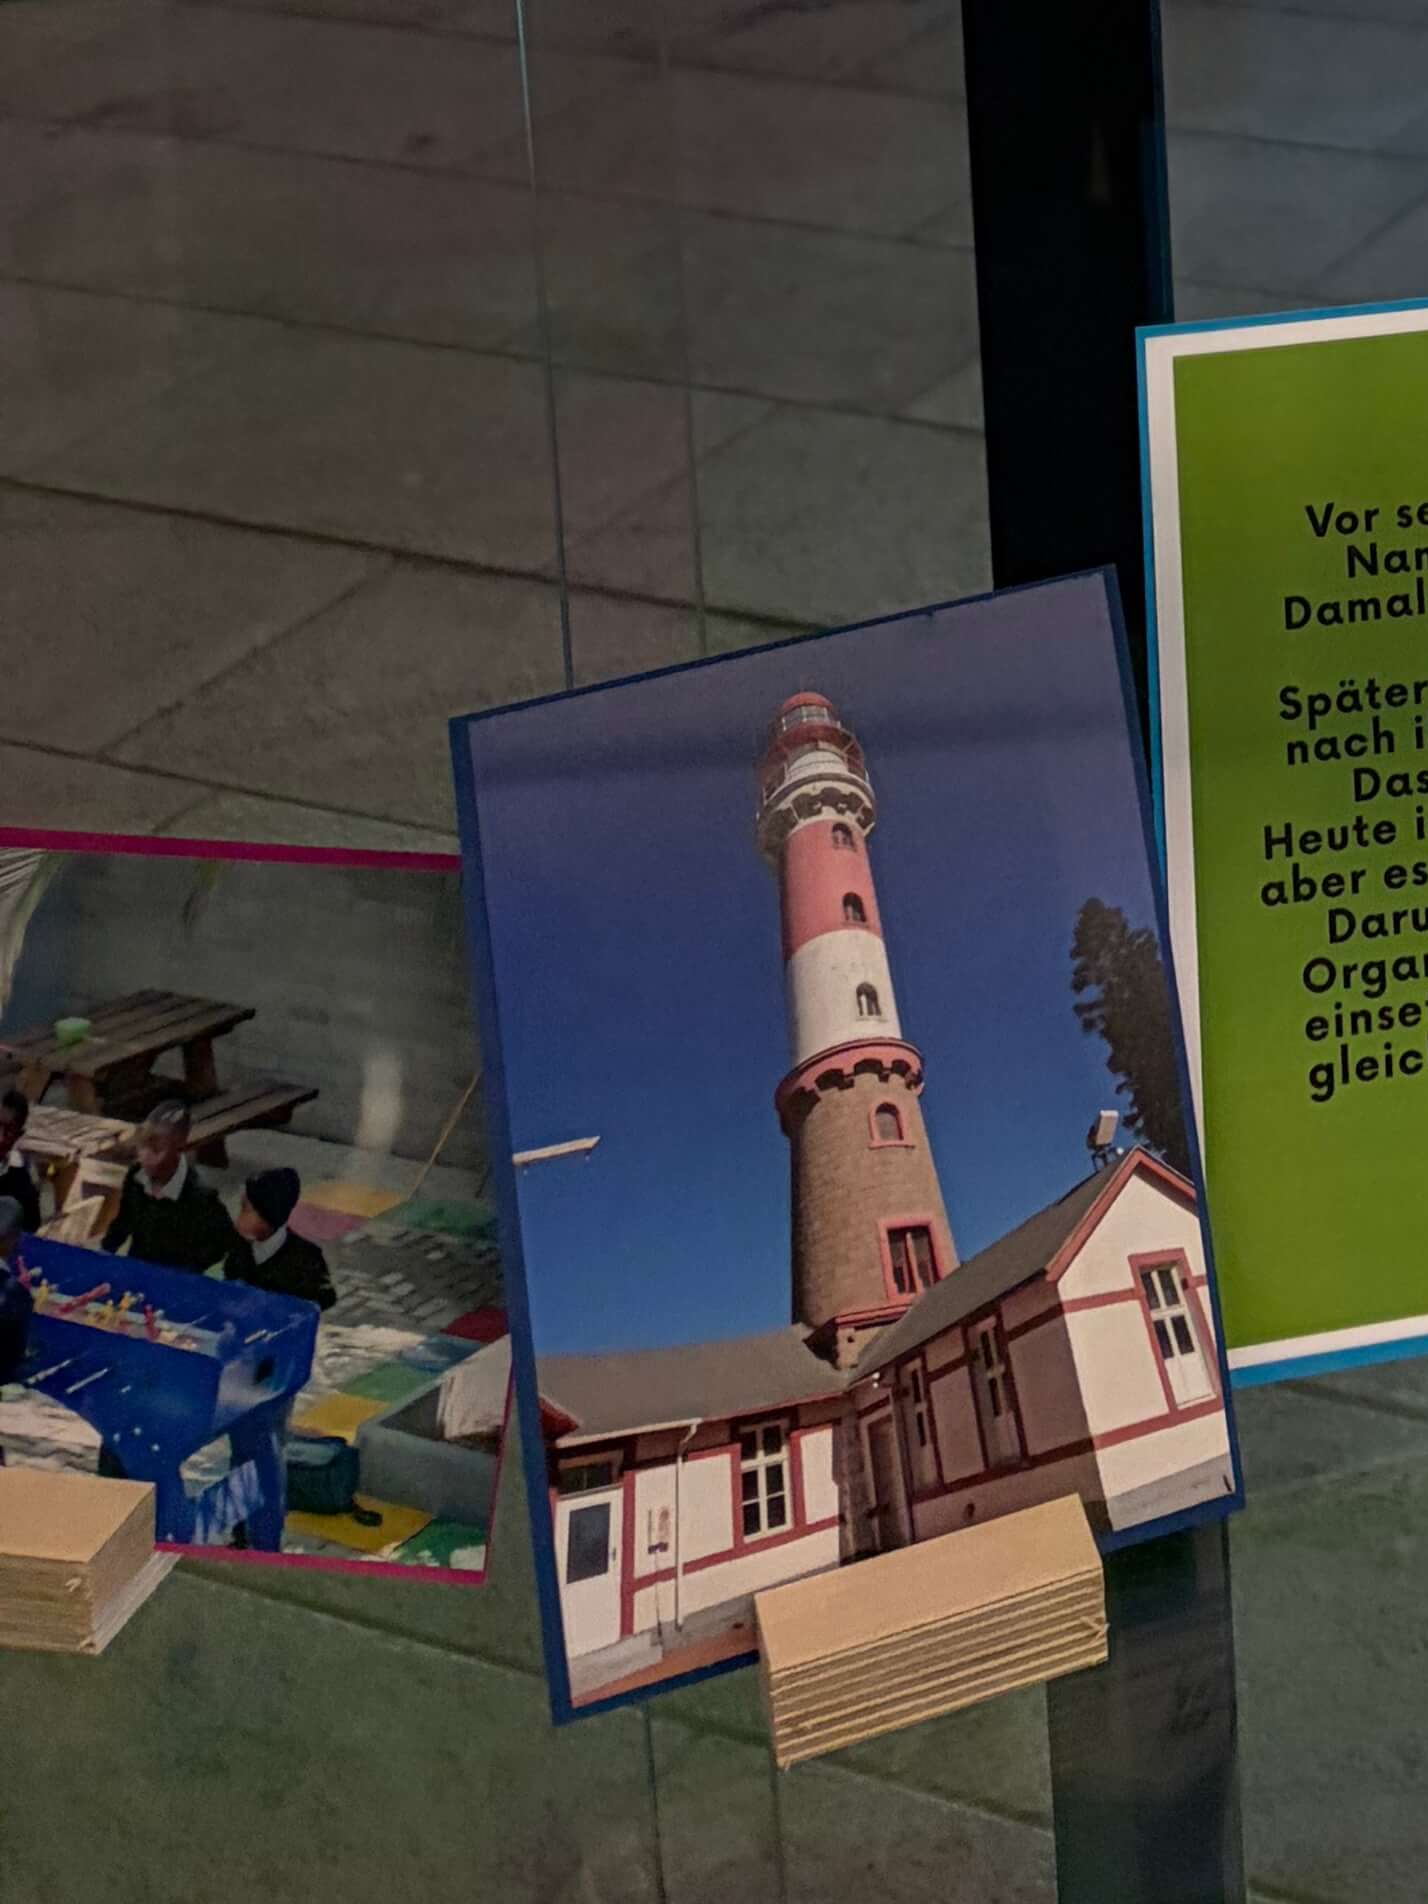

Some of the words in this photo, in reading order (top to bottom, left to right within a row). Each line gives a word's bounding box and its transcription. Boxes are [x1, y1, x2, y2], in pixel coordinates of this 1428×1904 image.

[1305, 502, 1380, 537] Vor
[1280, 678, 1428, 728] Später
[1287, 715, 1395, 766] nach
[1264, 815, 1397, 860] Heute
[1261, 862, 1367, 907] aber
[1384, 861, 1428, 889] es
